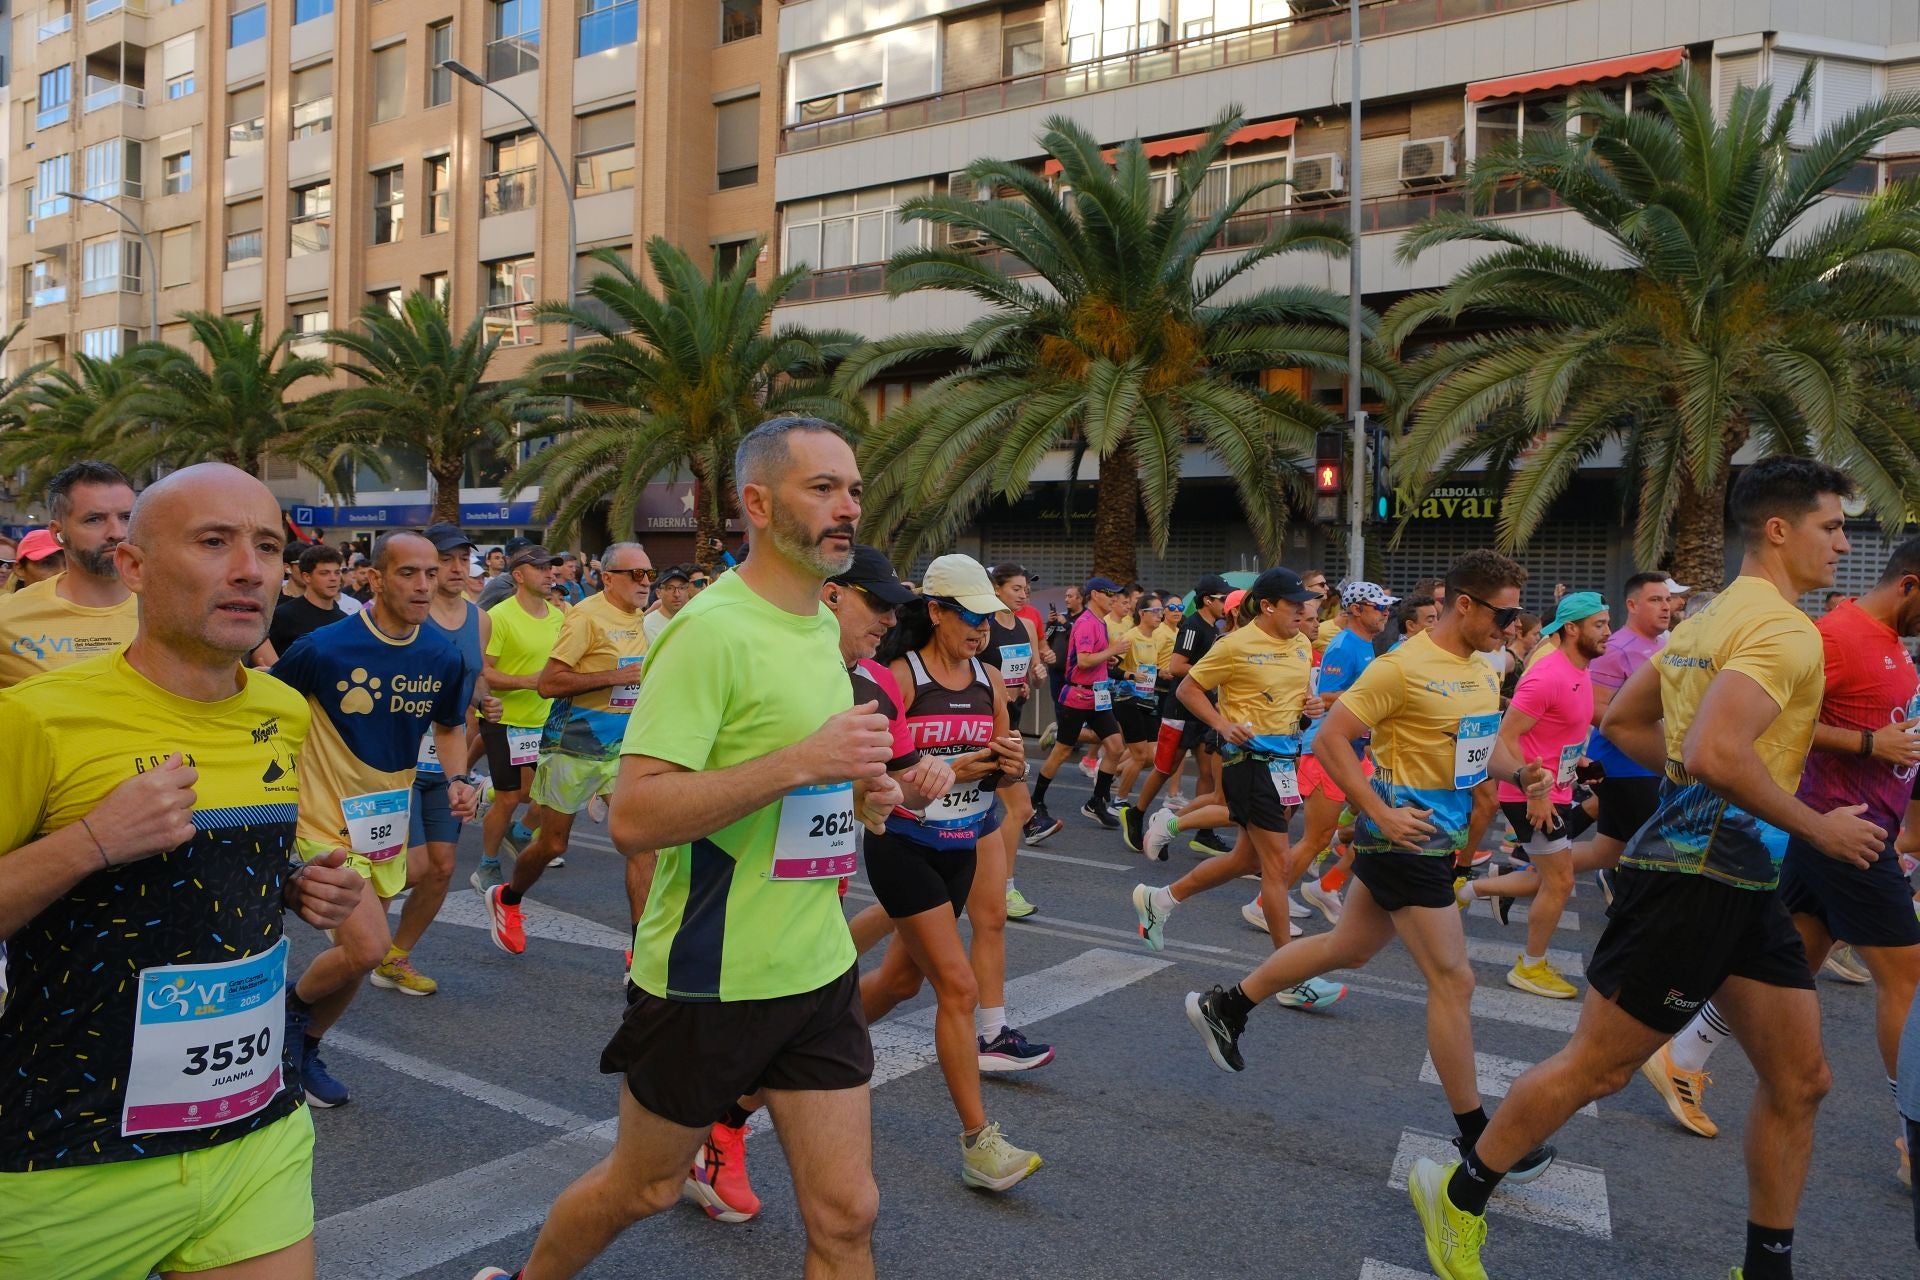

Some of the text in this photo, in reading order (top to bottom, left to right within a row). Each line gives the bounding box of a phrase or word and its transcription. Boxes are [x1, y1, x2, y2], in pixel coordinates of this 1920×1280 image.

[466, 512, 499, 520] Deutsche Bank
[647, 517, 687, 528] TABERNA
[49, 638, 73, 653] VI
[391, 674, 442, 693] Guide
[390, 695, 433, 718] Dogs
[952, 745, 963, 753] ES
[135, 753, 196, 775] GOK
[942, 788, 980, 808] 3742
[370, 823, 392, 841] 582
[809, 809, 854, 838] 2622
[229, 979, 245, 987] Gran
[198, 982, 227, 1004] VI
[240, 993, 261, 1008] 2025
[182, 1026, 271, 1076] 3530
[211, 1068, 254, 1087] JUANMA
